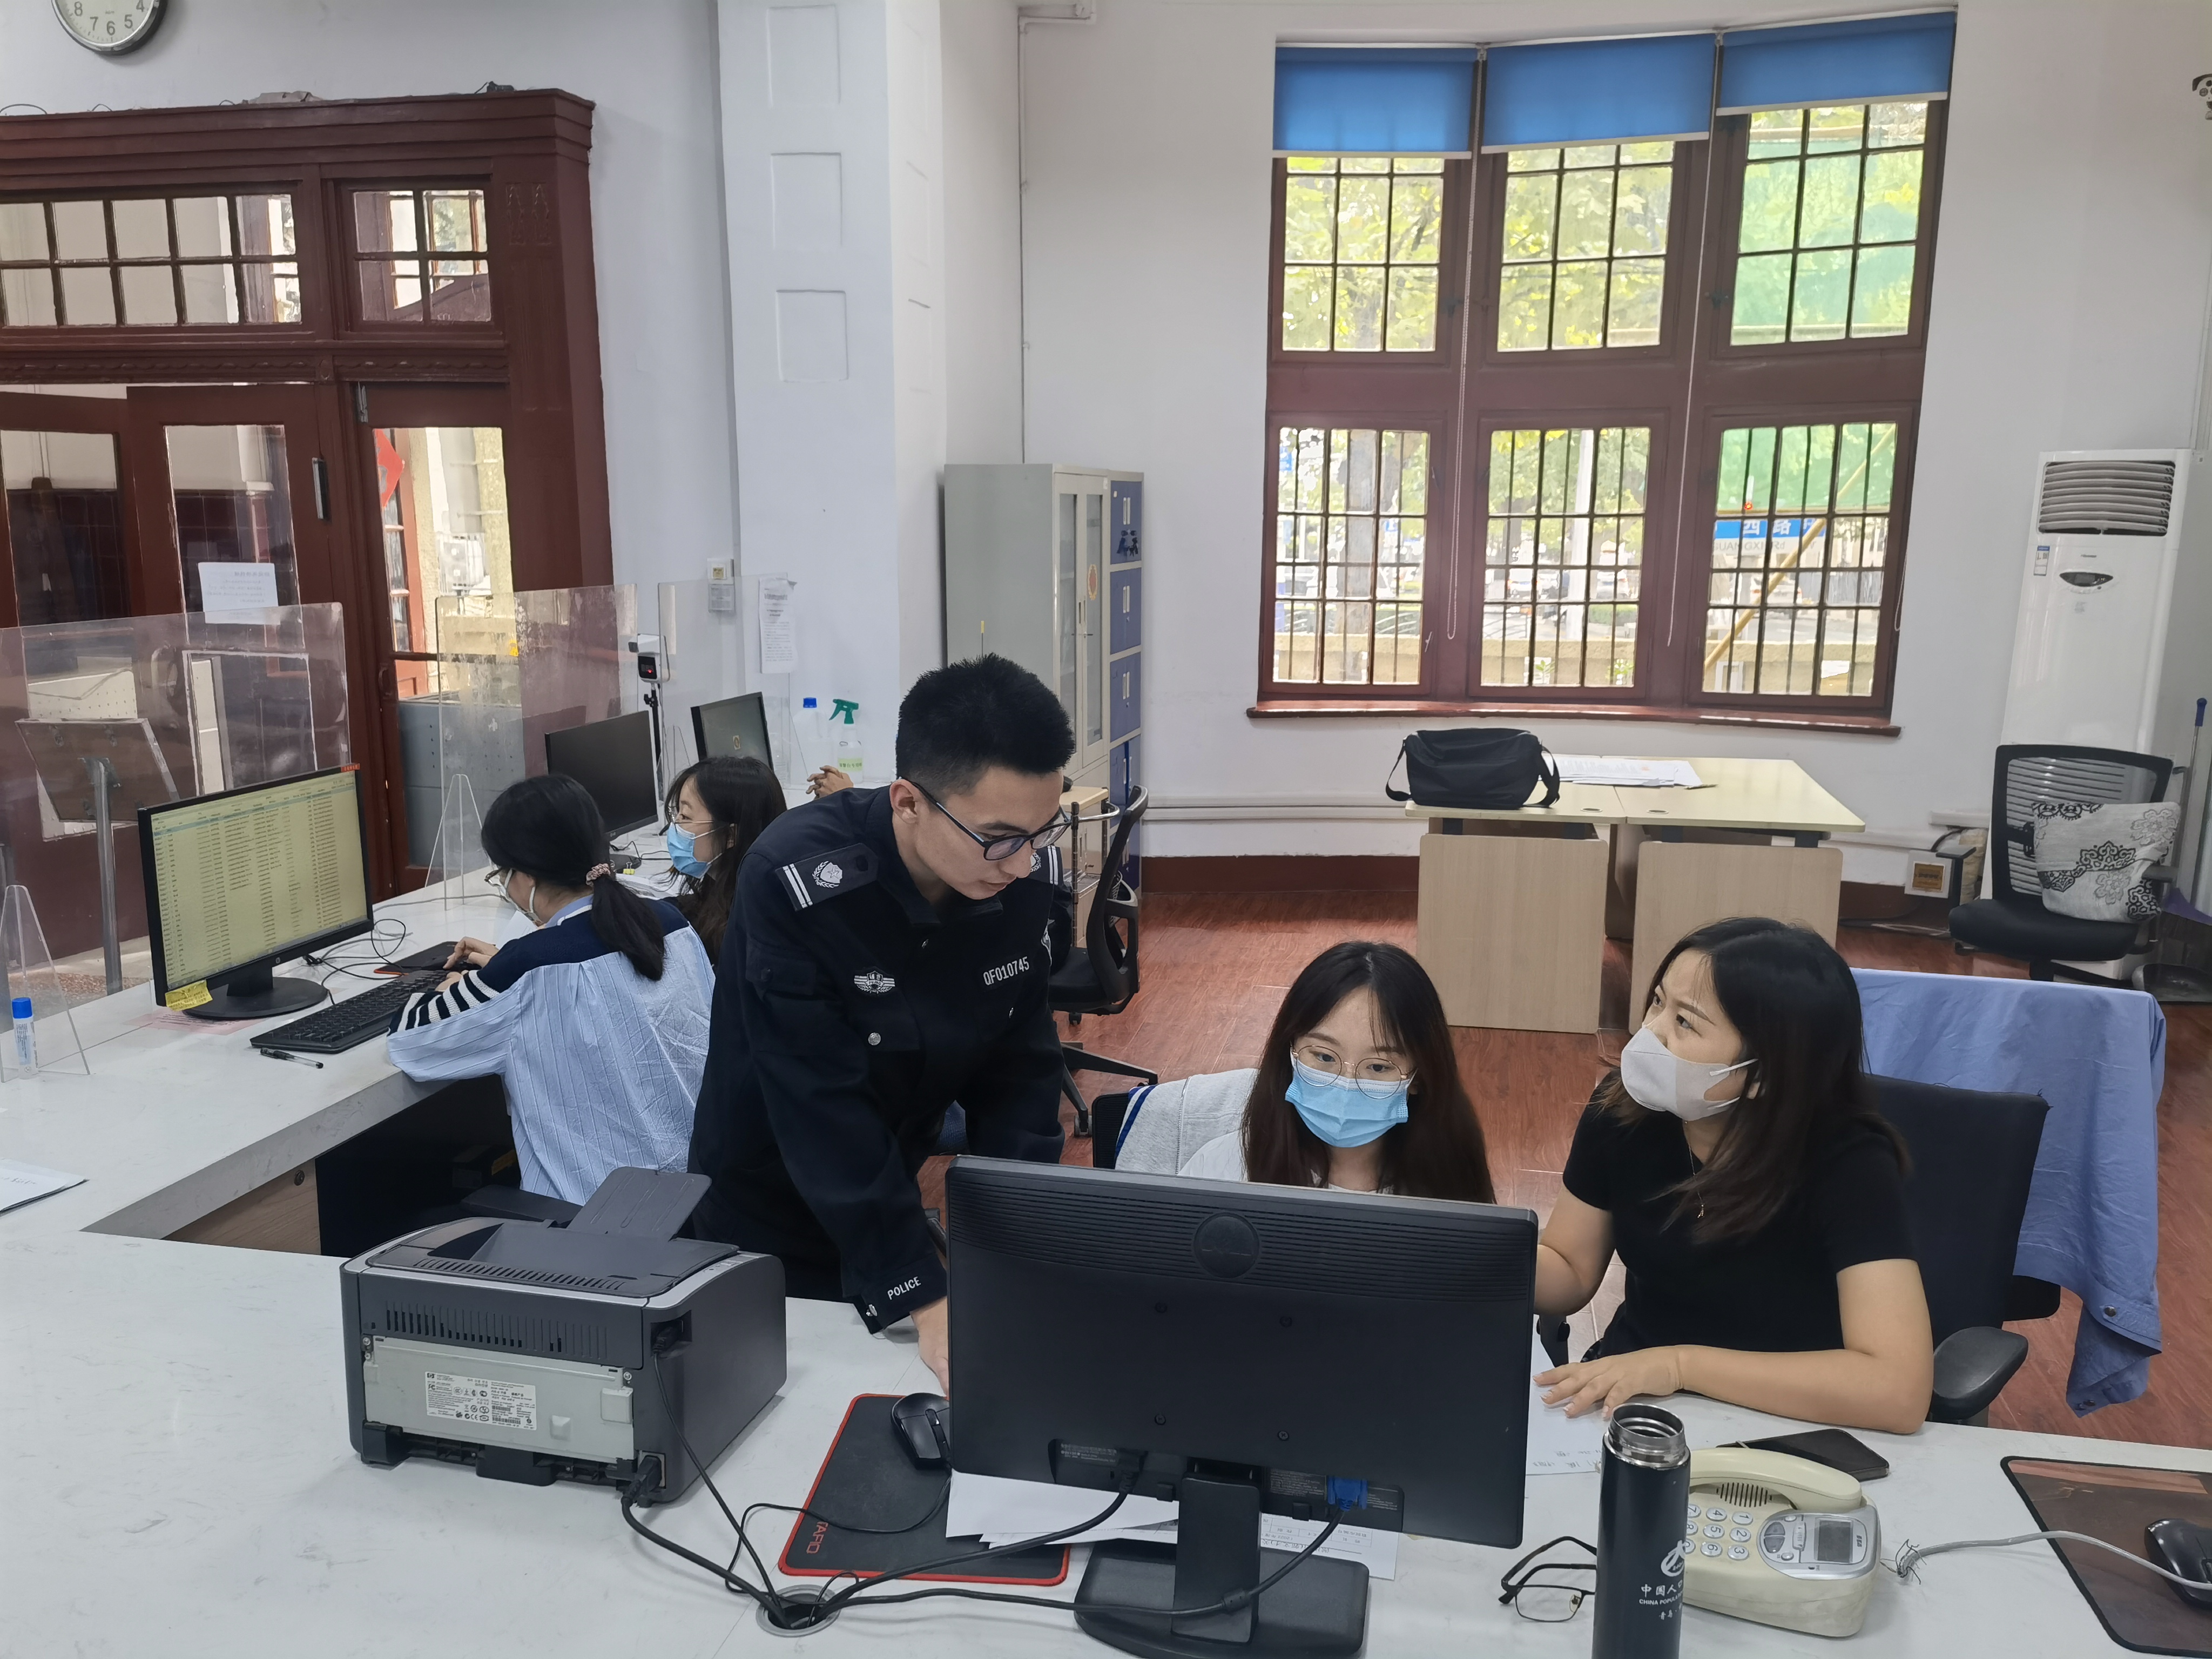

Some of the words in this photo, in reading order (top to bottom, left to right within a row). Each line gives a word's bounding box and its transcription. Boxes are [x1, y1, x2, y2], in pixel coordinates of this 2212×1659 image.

[74, 1, 83, 17] 8
[136, 0, 145, 12] 4
[90, 16, 98, 31] 7
[106, 21, 115, 36] 6
[124, 14, 133, 29] 5
[983, 956, 1029, 986] QF010745
[887, 1277, 921, 1300] POLICE
